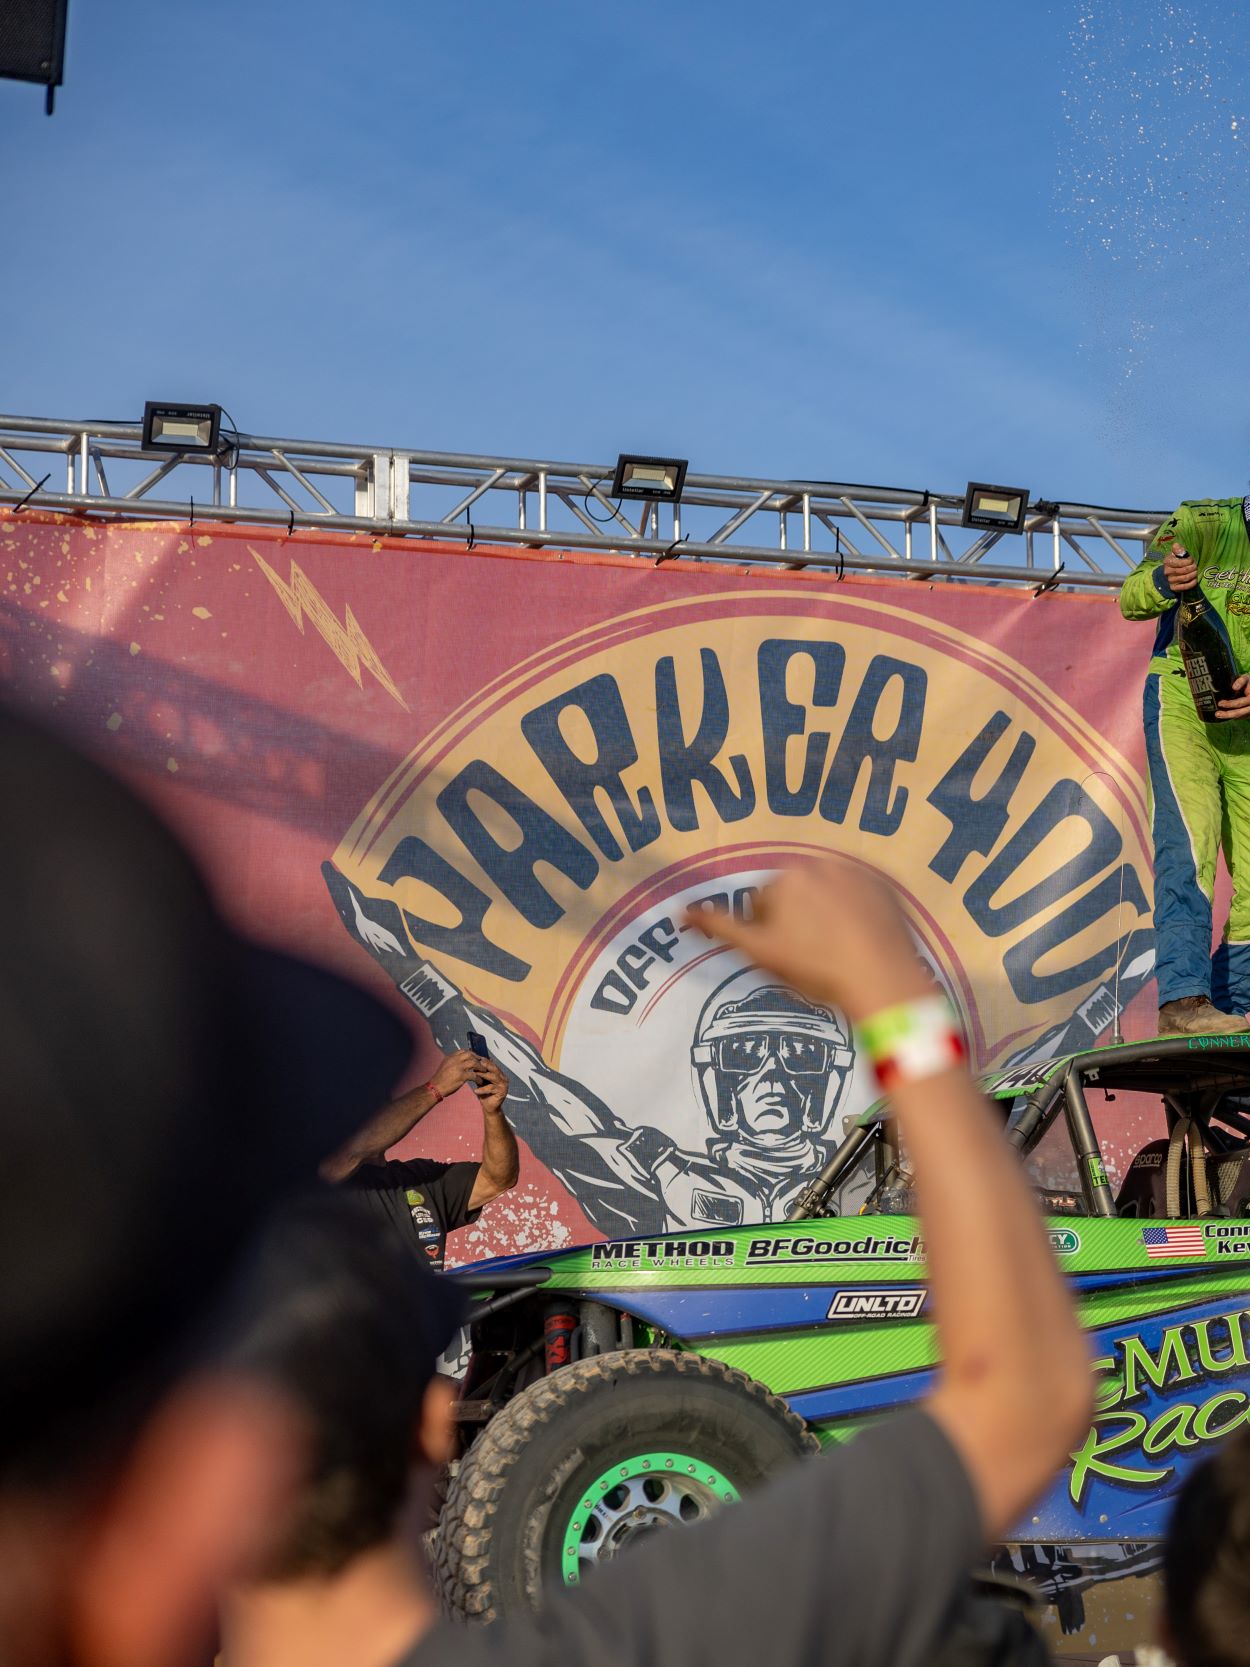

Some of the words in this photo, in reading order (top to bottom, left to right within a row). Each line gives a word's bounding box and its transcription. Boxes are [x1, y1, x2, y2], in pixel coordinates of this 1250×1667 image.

[1203, 565, 1237, 581] Get
[377, 638, 928, 982] PARKER
[926, 709, 1153, 1005] 400
[1133, 1153, 1163, 1166] sparco
[592, 1240, 736, 1260] METHOD
[746, 1235, 925, 1259] BFGoodrich
[592, 1260, 642, 1269] RACE
[653, 1257, 735, 1268] WHEELS
[835, 1296, 918, 1313] UNLTD
